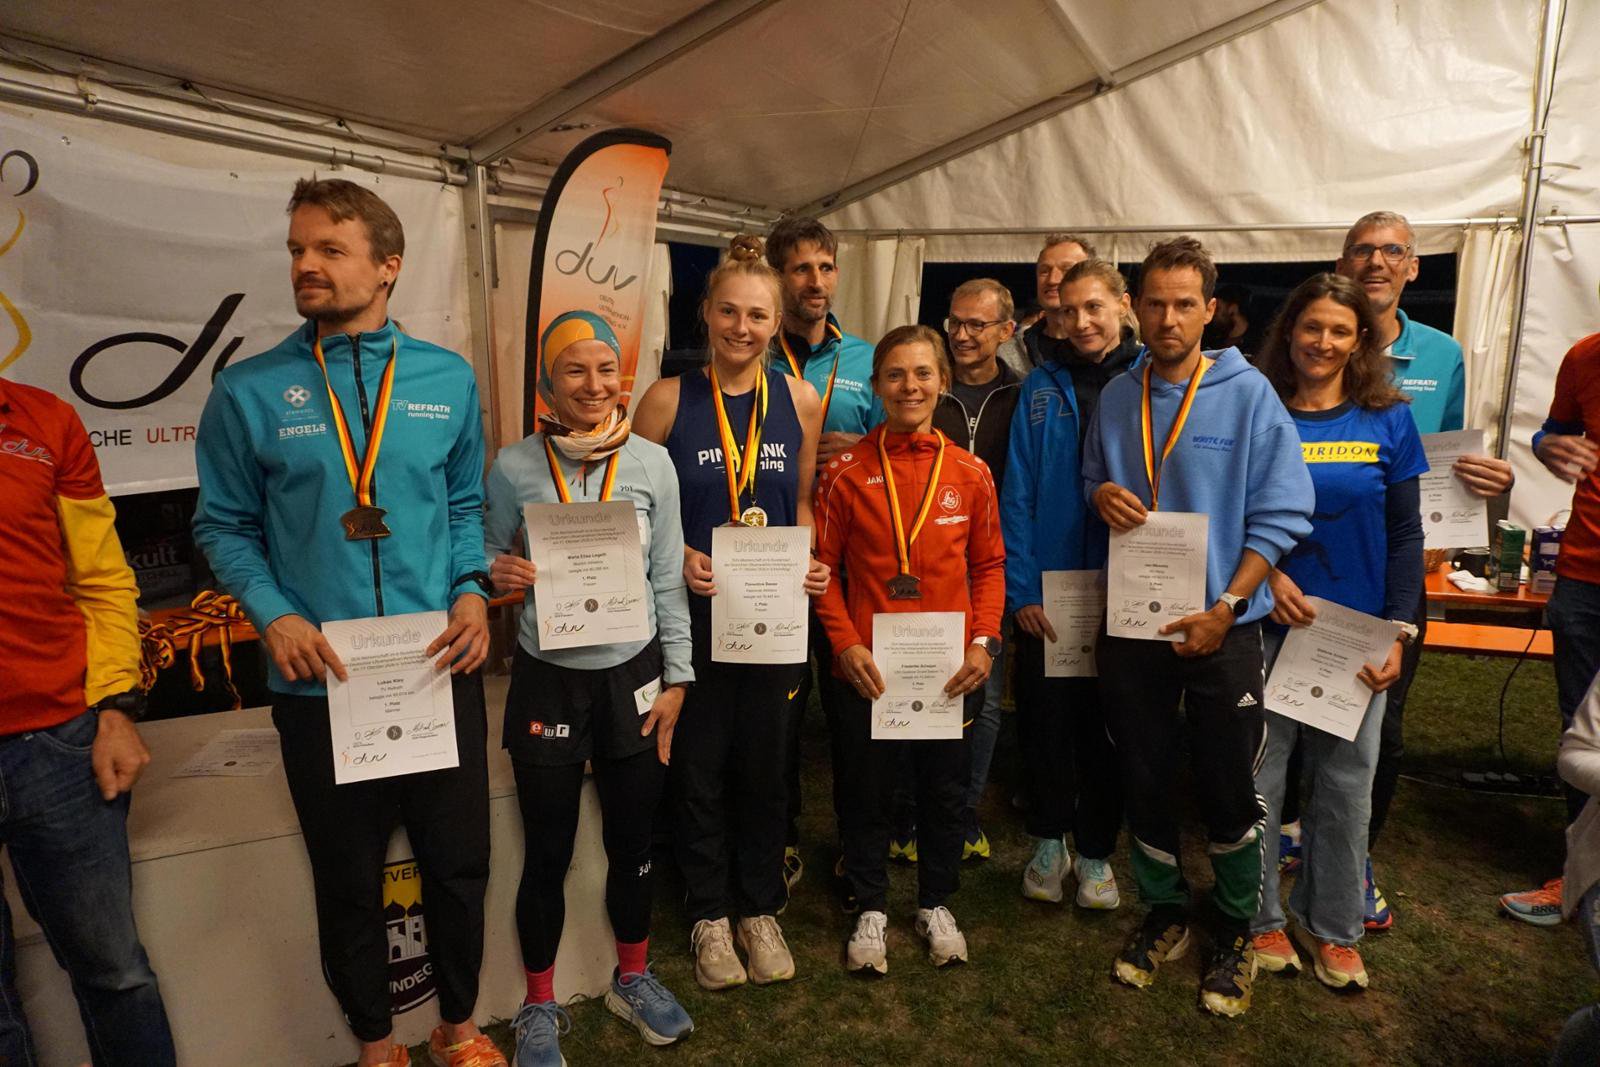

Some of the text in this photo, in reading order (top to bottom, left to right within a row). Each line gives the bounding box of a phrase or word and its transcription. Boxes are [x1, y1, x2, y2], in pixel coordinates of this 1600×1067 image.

[555, 241, 638, 291] duv
[408, 403, 450, 413] REFRATH
[279, 423, 327, 437] ENGELS
[760, 443, 788, 458] NK
[867, 476, 885, 485] JAK
[550, 511, 612, 526] Urkunde
[734, 539, 789, 553] Urkunde
[350, 628, 422, 650] Urkunde
[389, 962, 433, 994] NDEG
